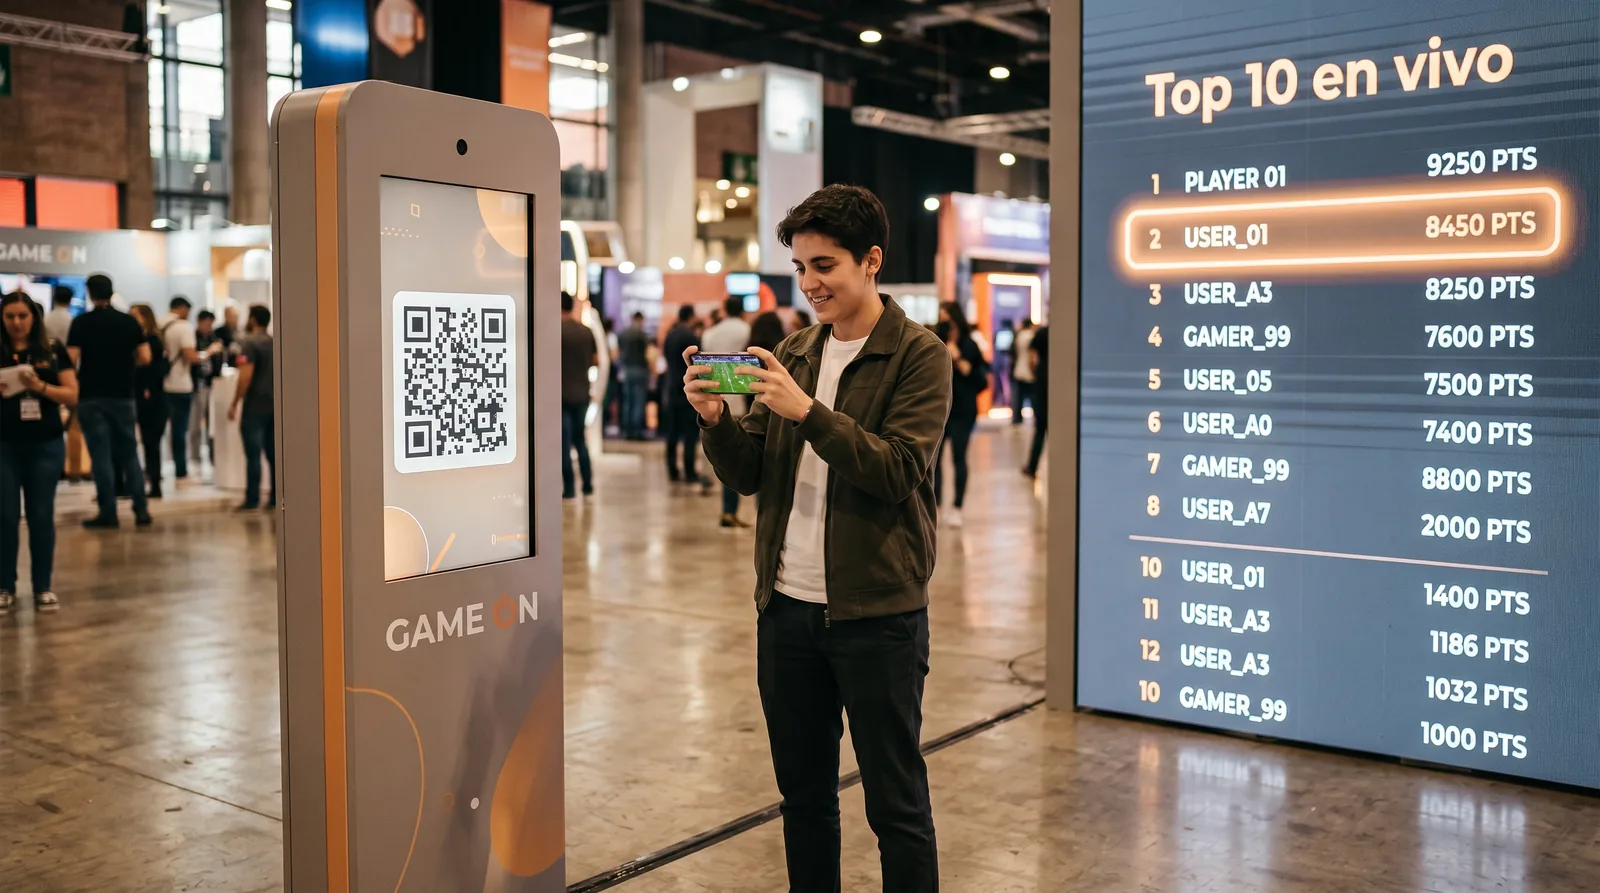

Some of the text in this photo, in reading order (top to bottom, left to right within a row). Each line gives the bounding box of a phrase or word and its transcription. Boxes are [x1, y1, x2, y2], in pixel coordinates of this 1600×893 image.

[1144, 35, 1514, 124] Top 10 en vivo
[1151, 146, 1538, 195] 1 PLAYER 01 9250 PTS
[0, 243, 87, 264] GAME ON
[1149, 210, 1537, 250] 2 USER_01 8450 PTS
[1148, 275, 1535, 307] 3 USER_A3 8250 PTS
[1147, 324, 1535, 352] 4 GAMER_99 7600 PTS
[1148, 368, 1534, 398] 5 USER_05 7500 PTS
[1147, 410, 1533, 447] 6 USER_A0 7400 PTS
[1147, 452, 1532, 495] 7 GAMER_99 8800 PTS
[1146, 494, 1532, 544] 8 USER_A7 2000 PTS
[1140, 555, 1531, 616] 10 USER_01 1400 PTS
[385, 591, 539, 652] GAME ON
[1142, 597, 1530, 664] 11 USER_A3 1186 PTS
[1140, 638, 1529, 711] 12 USER_A3 1032 PTS
[1138, 679, 1528, 759] 10 GAMER_99 1000 PTS
